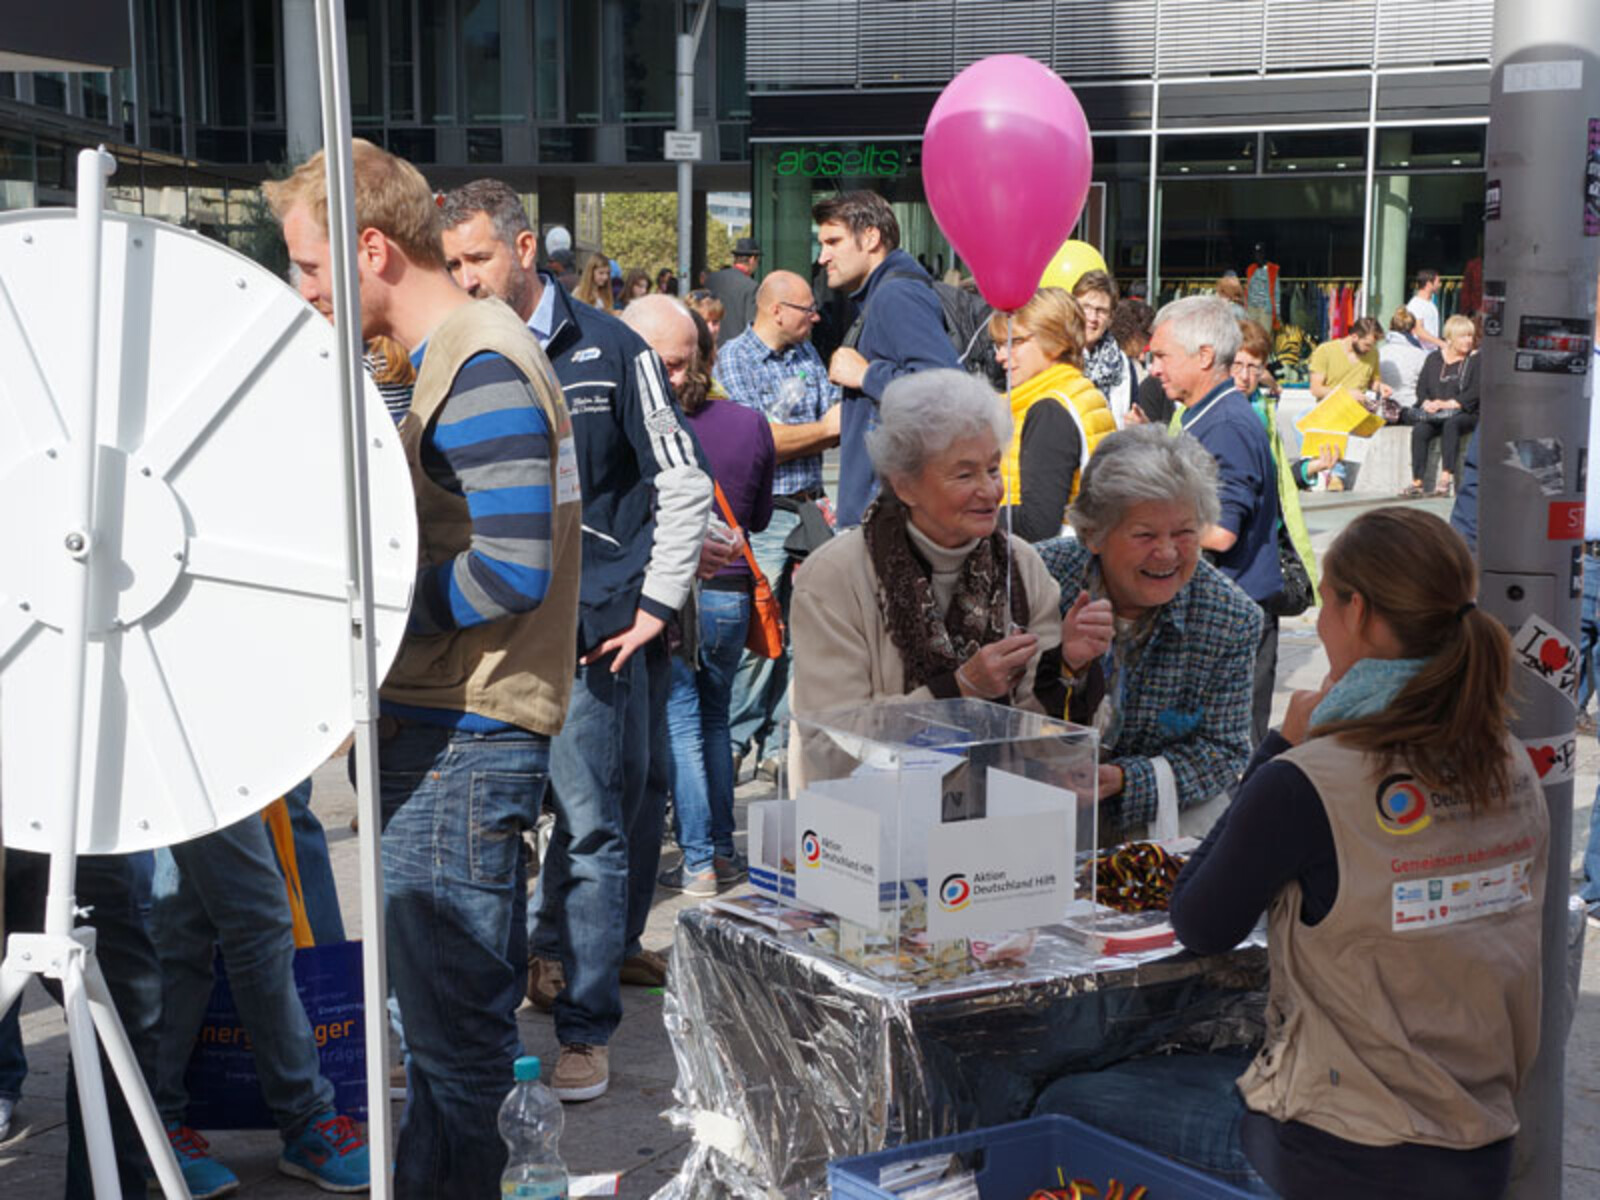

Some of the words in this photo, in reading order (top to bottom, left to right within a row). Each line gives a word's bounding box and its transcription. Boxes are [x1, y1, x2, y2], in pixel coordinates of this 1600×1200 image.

[777, 144, 899, 176] abseits
[822, 838, 843, 851] Aktion
[973, 871, 1006, 882] Aktion
[973, 878, 1032, 895] Deutschland
[1035, 875, 1056, 886] Hilft
